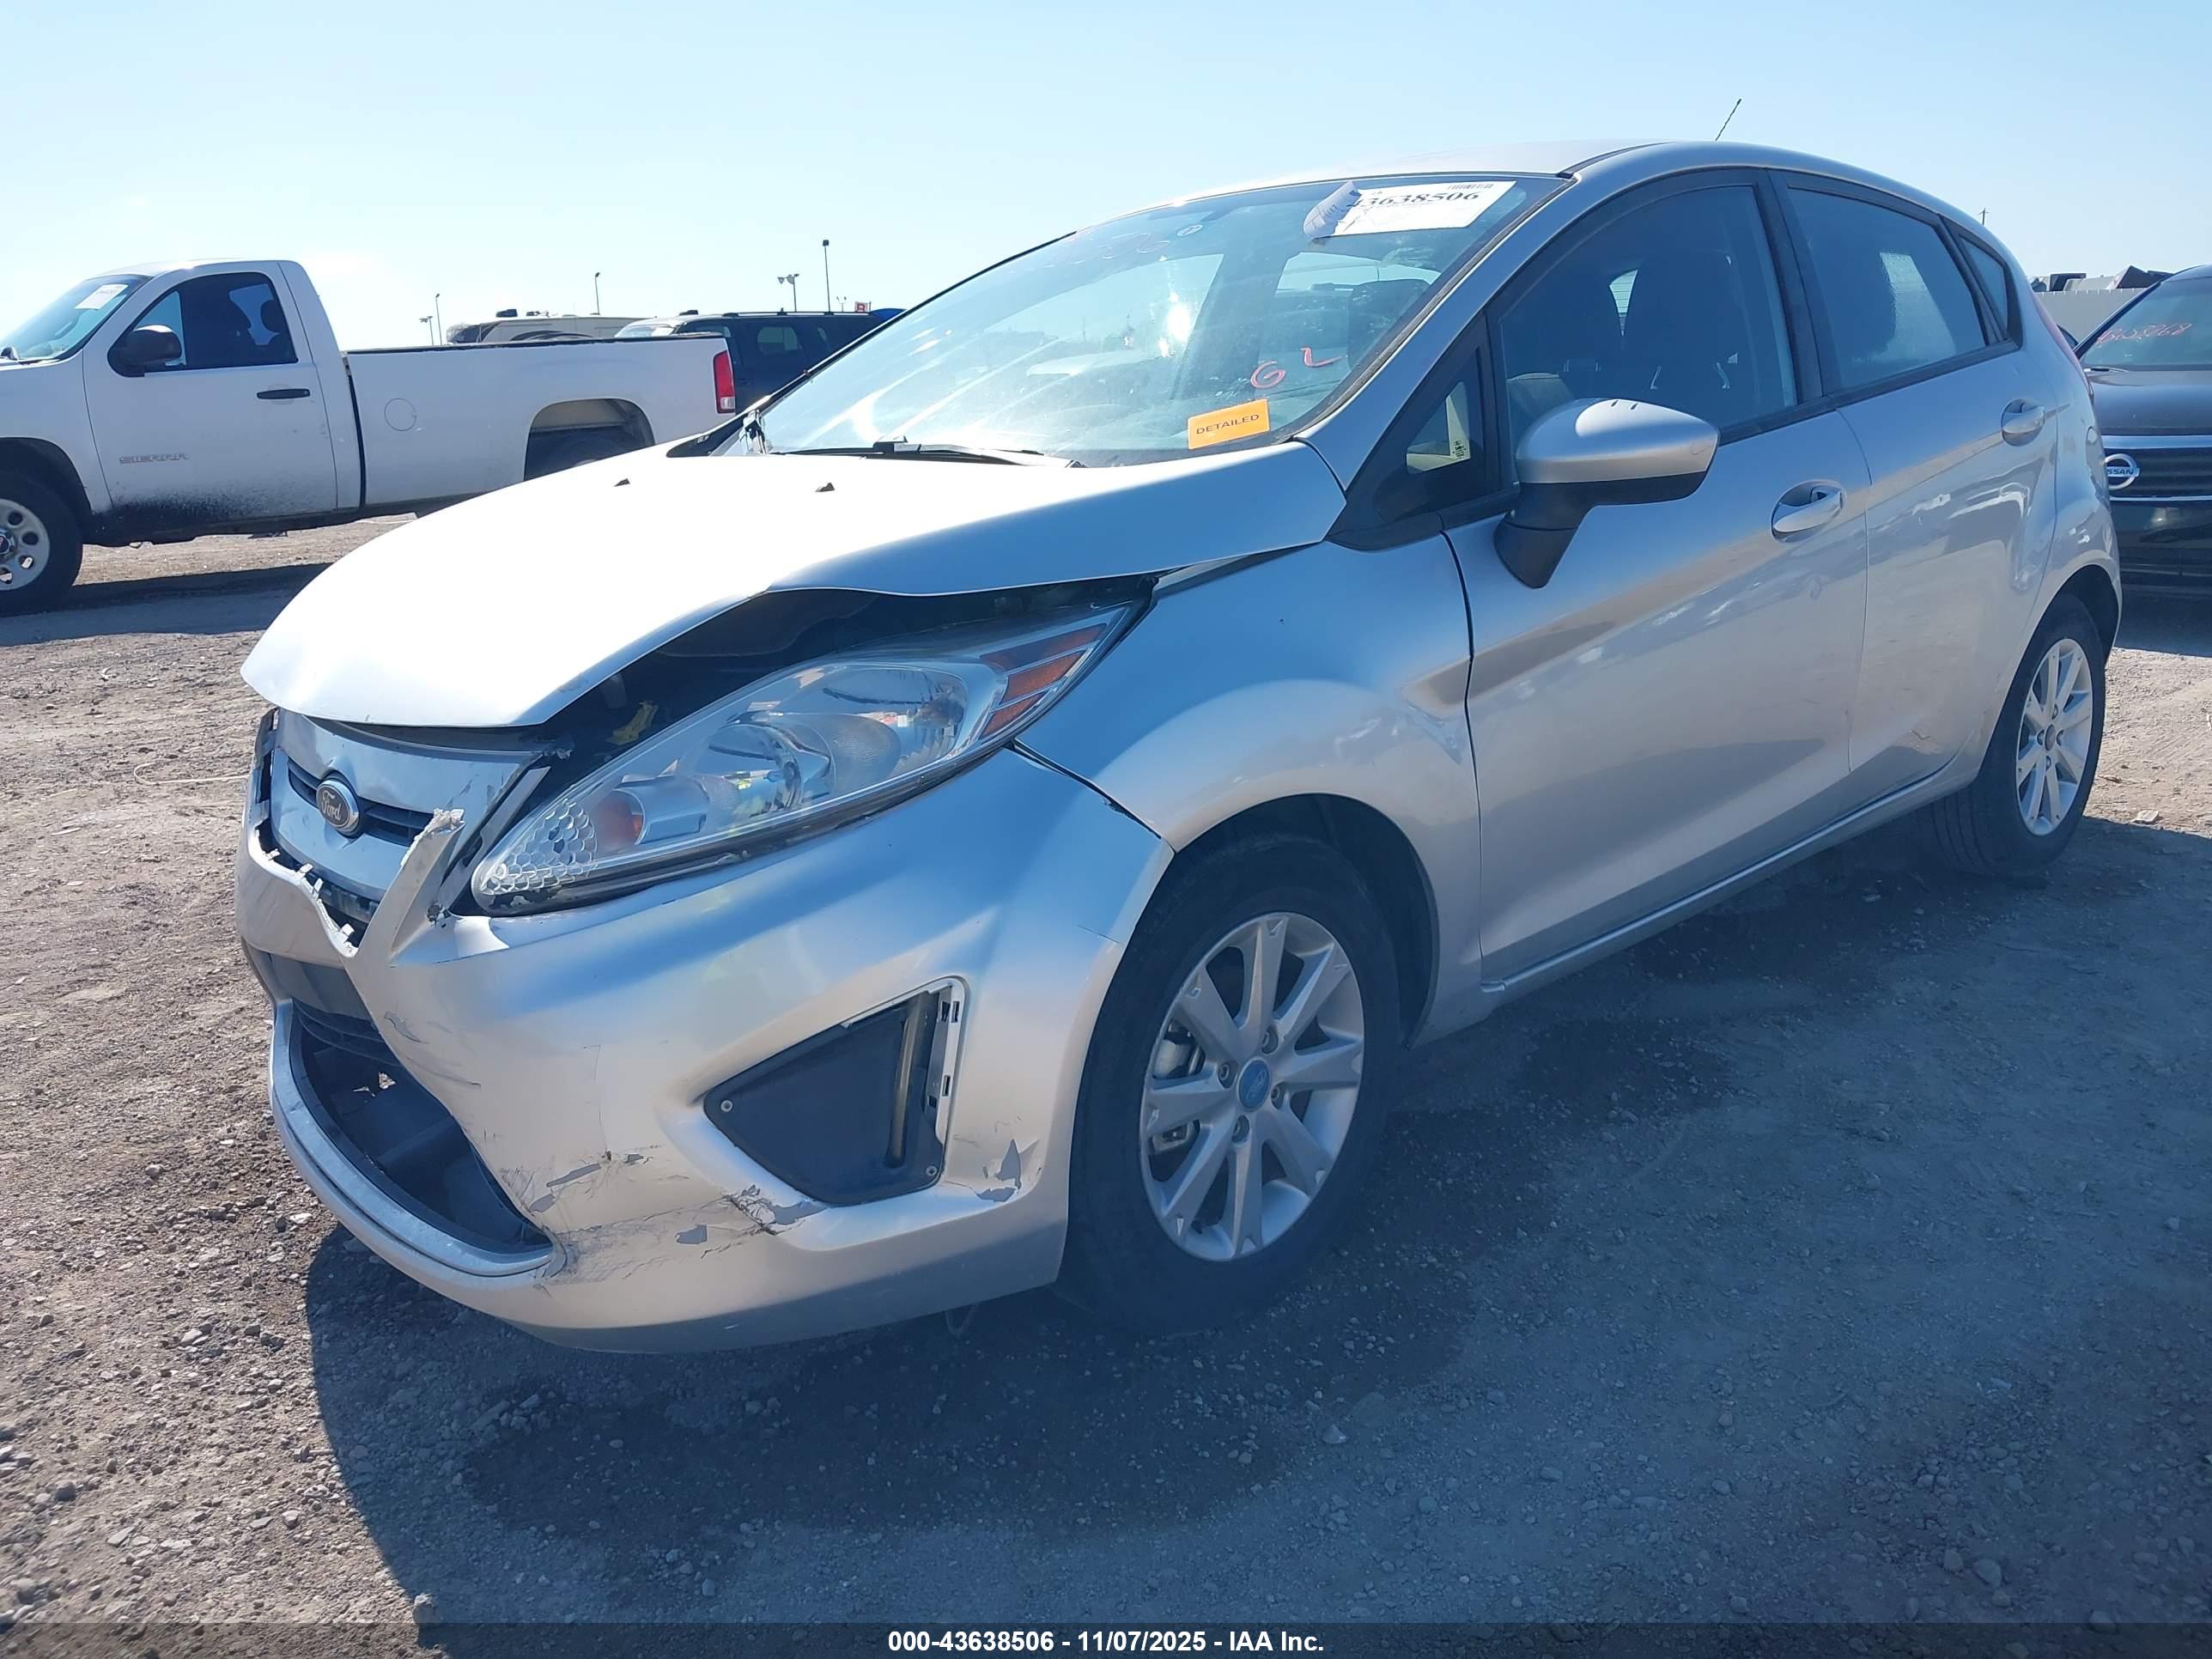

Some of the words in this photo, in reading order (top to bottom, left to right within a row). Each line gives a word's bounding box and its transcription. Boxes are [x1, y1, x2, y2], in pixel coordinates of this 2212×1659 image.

[1196, 414, 1260, 434] DETAILED
[119, 453, 190, 464] SIERRA
[321, 789, 342, 821] Ford
